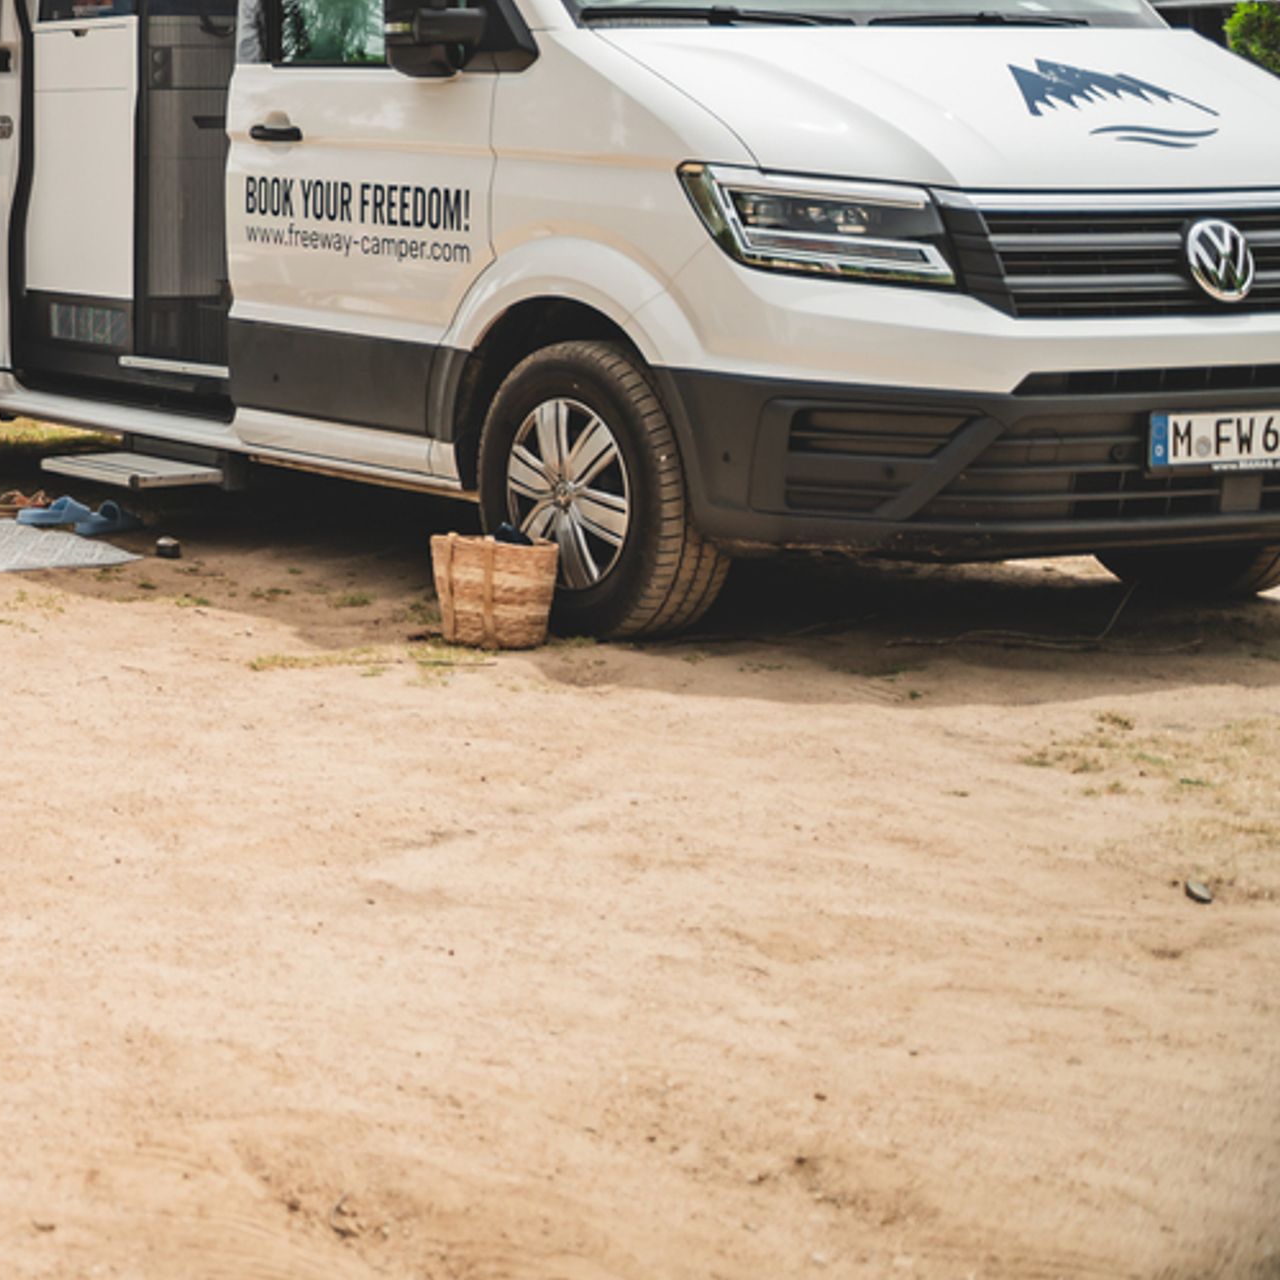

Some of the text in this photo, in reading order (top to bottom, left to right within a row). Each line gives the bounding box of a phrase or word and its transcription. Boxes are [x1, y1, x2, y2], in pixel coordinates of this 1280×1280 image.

[245, 176, 471, 232] BOOK YOUR FREEDOM!
[245, 222, 472, 263] www.freeway-camper.com
[1189, 221, 1251, 298] VW
[1172, 419, 1192, 457] M
